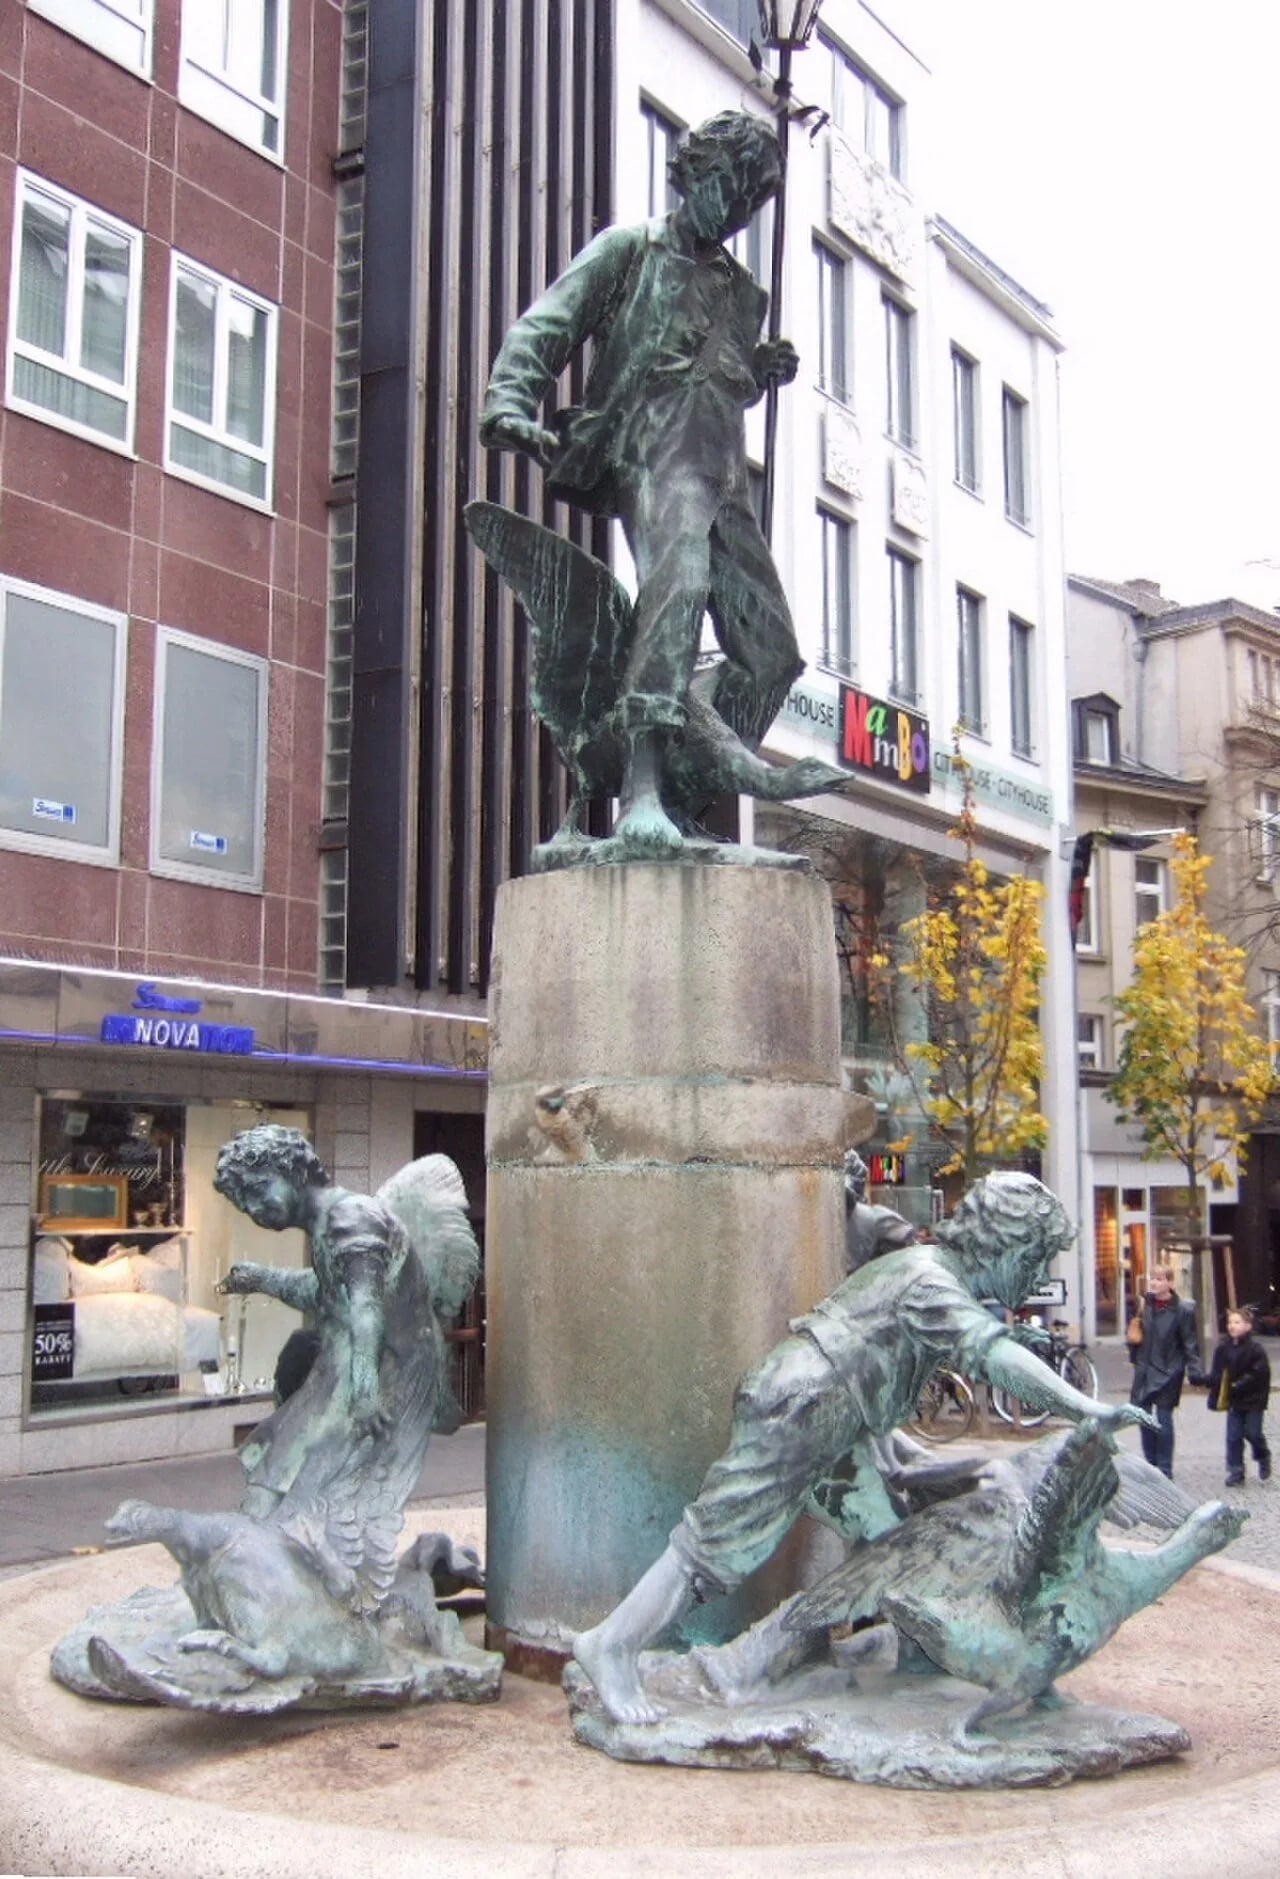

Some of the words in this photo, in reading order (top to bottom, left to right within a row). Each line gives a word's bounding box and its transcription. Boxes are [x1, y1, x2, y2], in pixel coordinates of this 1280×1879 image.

[998, 777, 1049, 815] CITYHOUSE
[134, 1018, 200, 1049] NOVA
[35, 1332, 73, 1355] 50%
